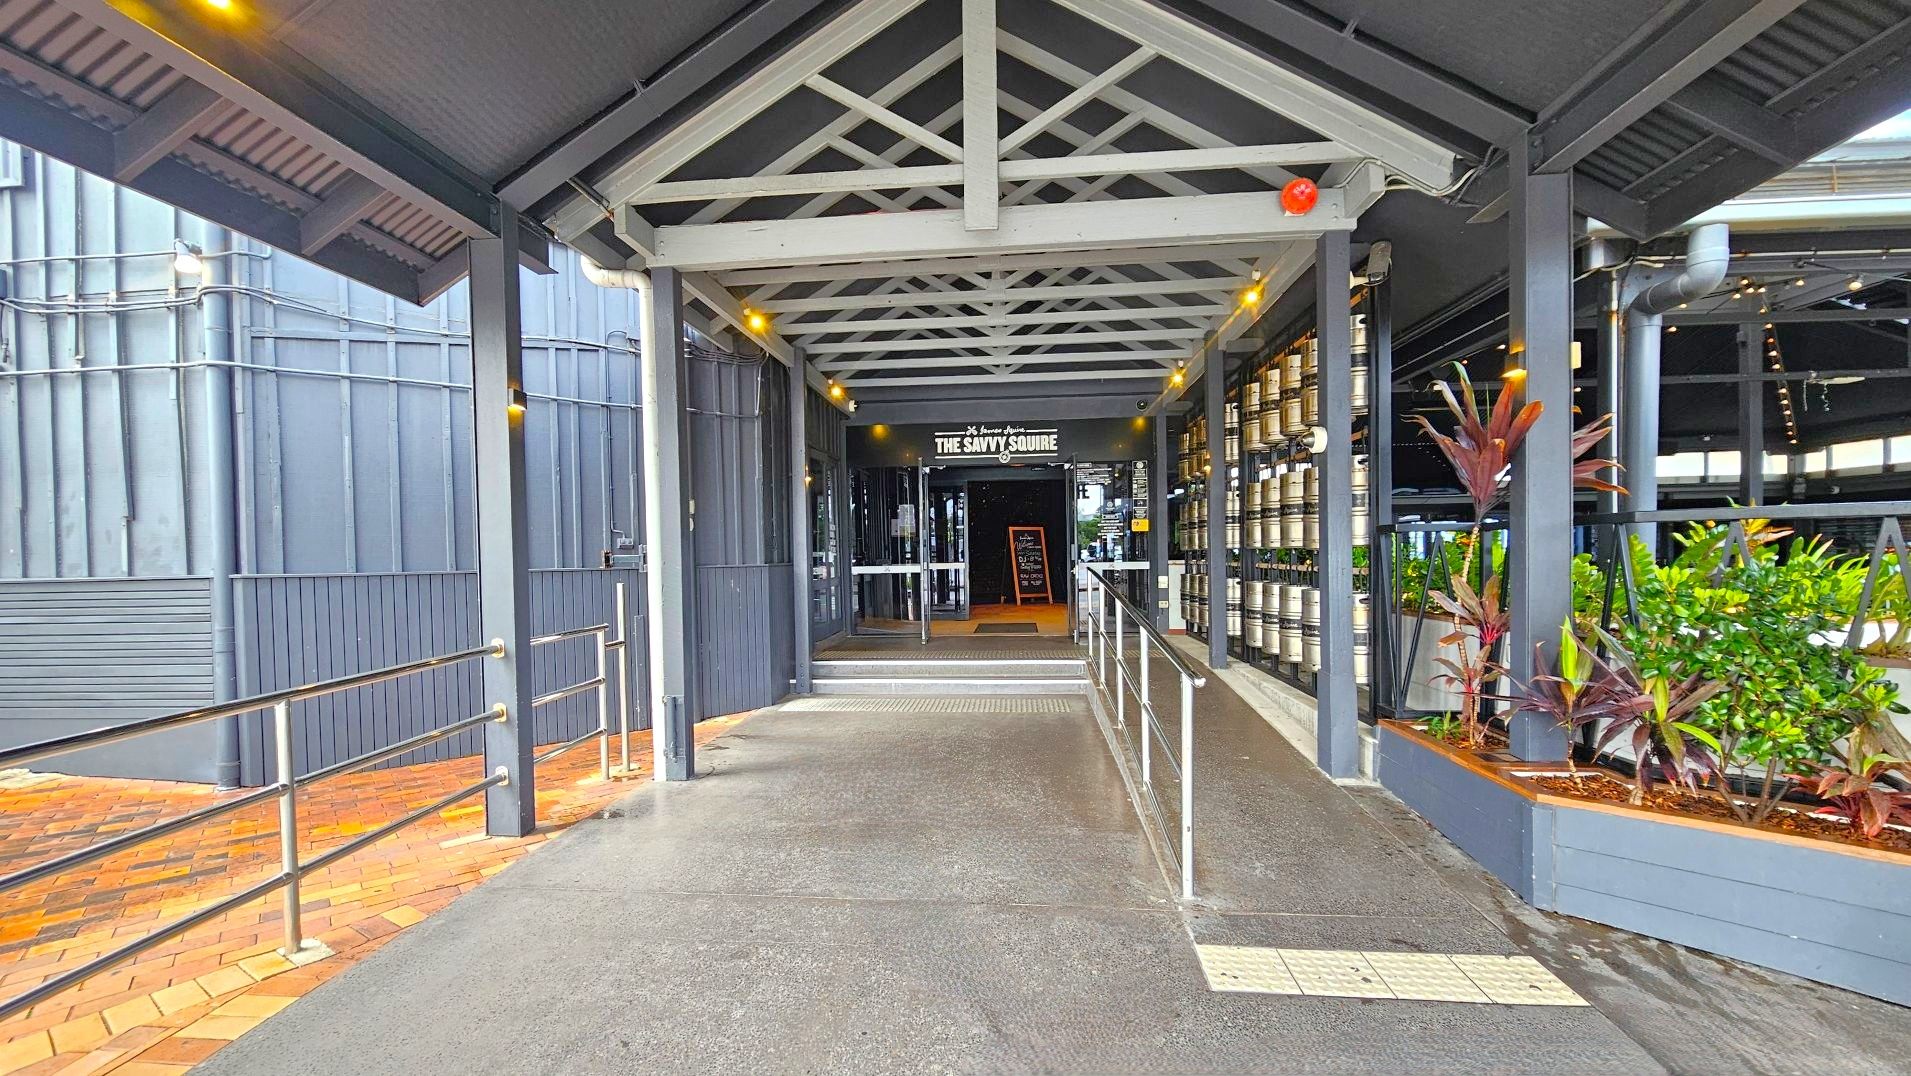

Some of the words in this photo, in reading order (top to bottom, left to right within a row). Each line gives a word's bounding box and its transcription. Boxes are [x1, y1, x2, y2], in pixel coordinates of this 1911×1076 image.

[935, 437, 961, 453] THE
[963, 436, 1007, 453] SAVVY
[1008, 434, 1058, 451] SQUIRE
